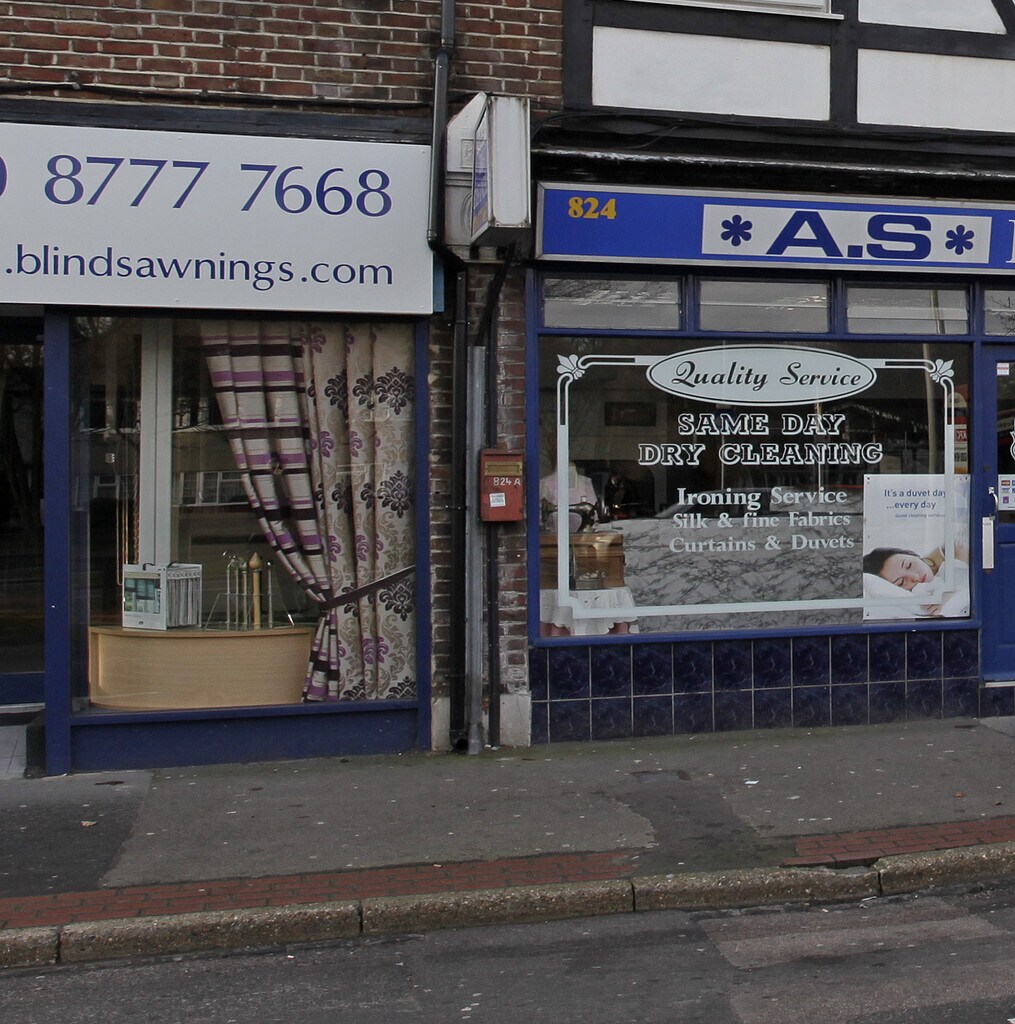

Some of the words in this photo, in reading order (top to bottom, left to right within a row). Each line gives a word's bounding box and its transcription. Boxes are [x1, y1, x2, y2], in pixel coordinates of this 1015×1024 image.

[44, 154, 211, 209] 8777
[240, 163, 393, 217] 7668
[567, 196, 617, 220] 824
[766, 210, 932, 260] A.S
[672, 360, 768, 392] Quality
[779, 362, 862, 387] Service
[678, 413, 770, 436] SAME
[781, 413, 846, 436] DAY
[637, 444, 706, 465] DRY
[719, 443, 883, 465] CLEANING
[493, 477, 511, 486] 824
[514, 477, 521, 486] A
[676, 487, 761, 510] Ironing
[771, 486, 848, 504] Service
[884, 489, 898, 497] It's
[906, 489, 930, 497] duvet
[920, 501, 936, 510] day
[672, 513, 709, 529] Silk
[717, 513, 734, 528] &
[743, 512, 780, 527] fine
[789, 511, 851, 527] Fabrics
[669, 536, 756, 553] Curtains
[764, 535, 781, 551] &
[791, 534, 855, 550] Duvets
